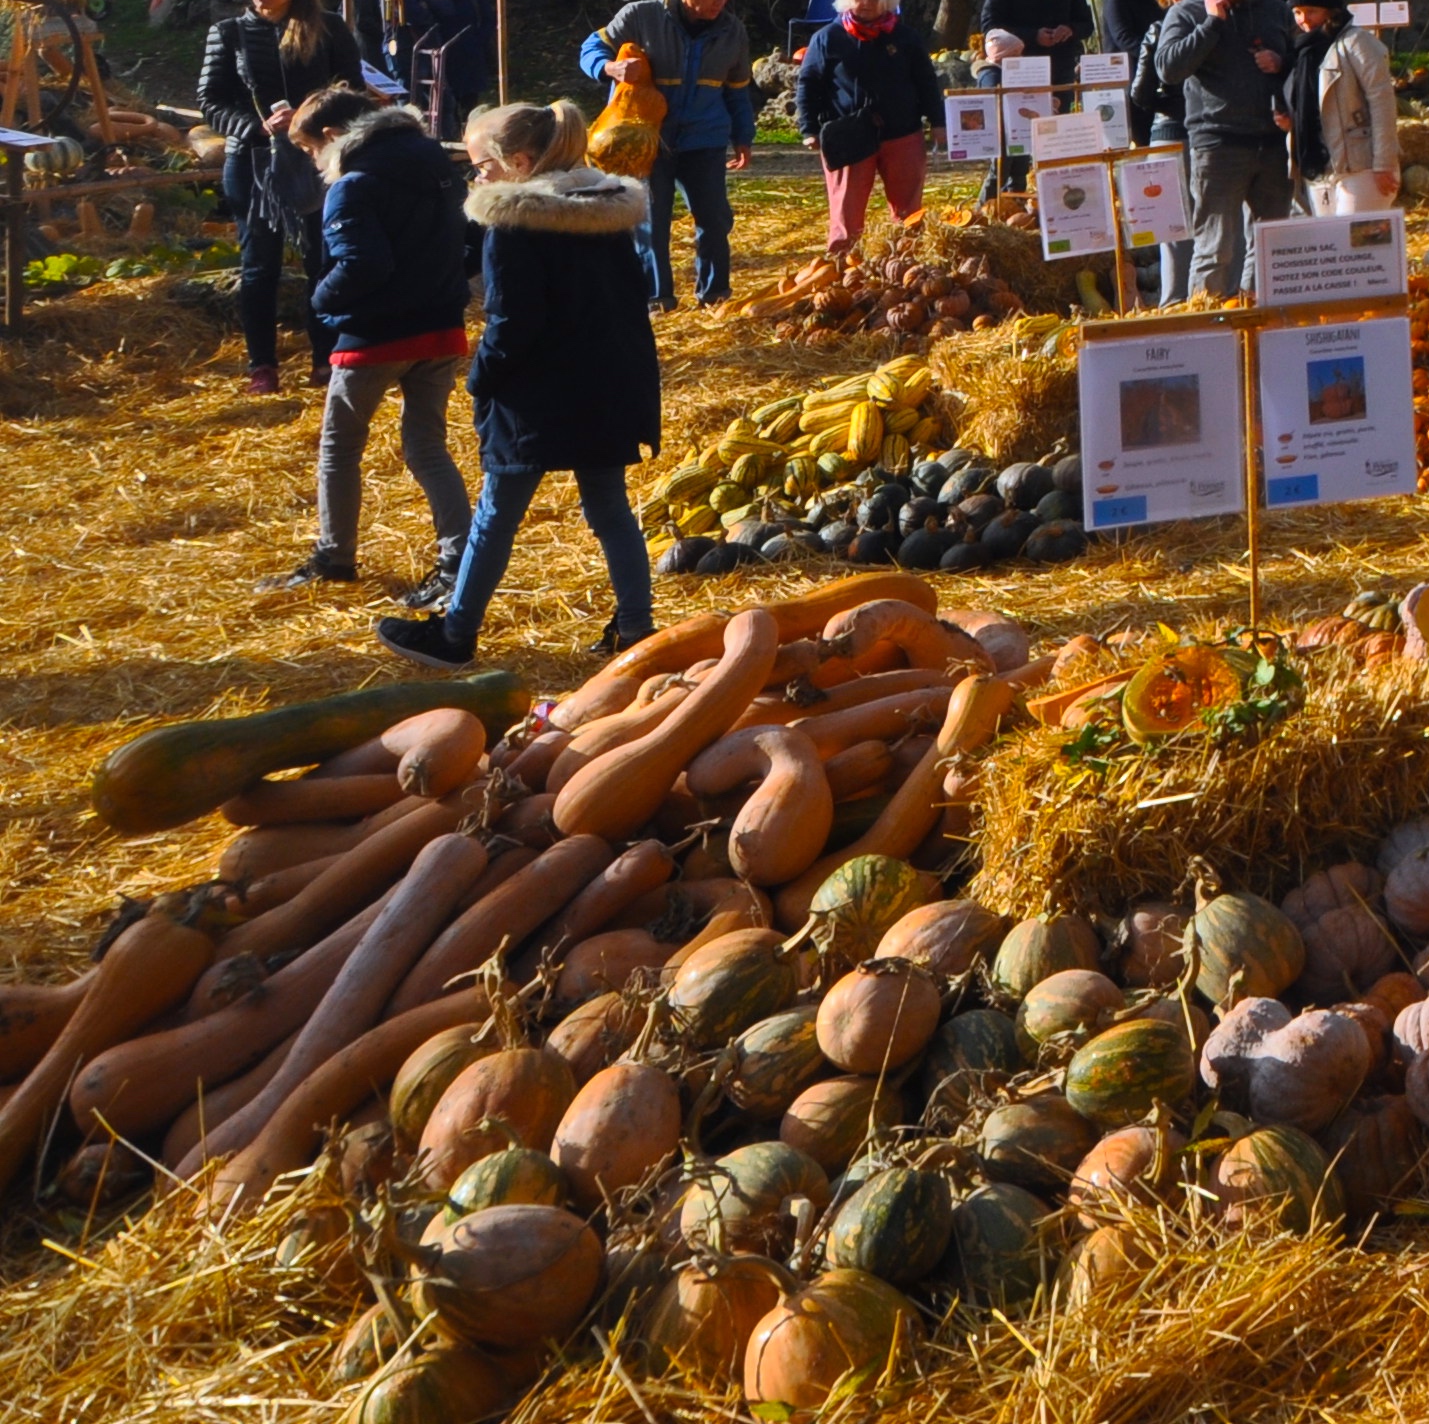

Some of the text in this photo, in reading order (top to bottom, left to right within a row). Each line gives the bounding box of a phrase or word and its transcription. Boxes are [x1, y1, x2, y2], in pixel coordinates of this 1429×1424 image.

[1271, 247, 1303, 256] PRENEZ
[1304, 245, 1317, 253] UN
[1271, 252, 1376, 269] CHOISISSEZ UNE COURGE,
[1272, 272, 1300, 282] NOTEZ
[1302, 271, 1319, 280] SON
[1321, 269, 1343, 278] CODE
[1273, 285, 1303, 295] PASSEZ
[1304, 284, 1311, 292] A
[1312, 283, 1323, 291] LA
[1324, 280, 1351, 290] CAISSE
[1145, 347, 1171, 362] FAIRY
